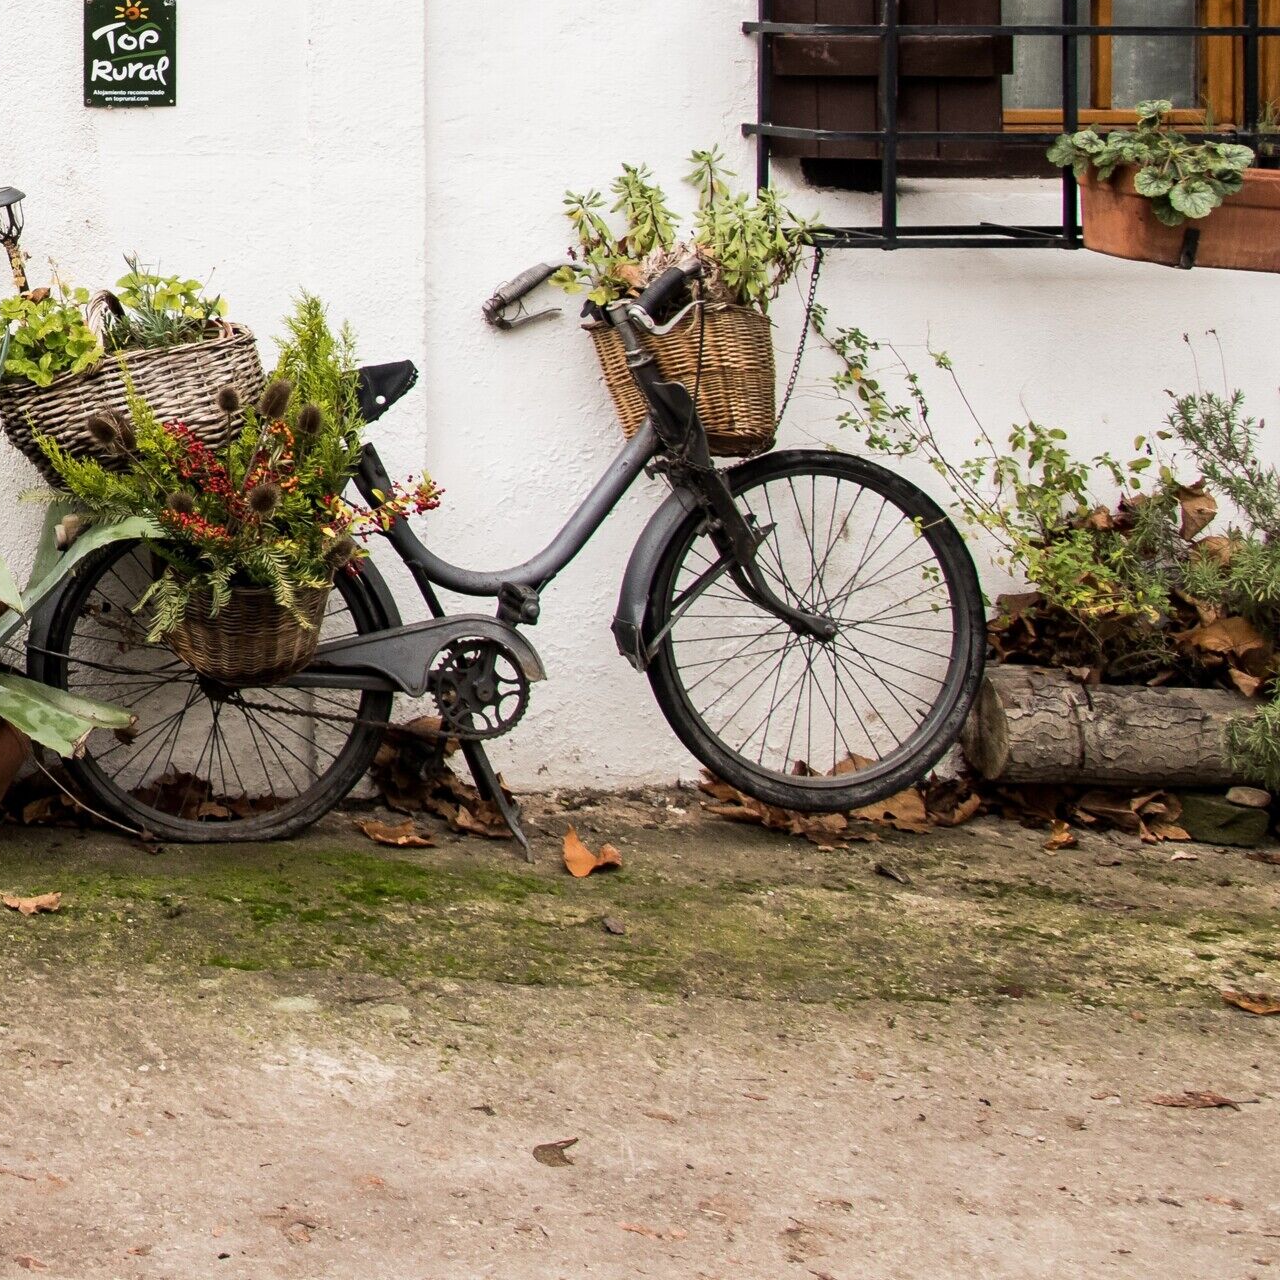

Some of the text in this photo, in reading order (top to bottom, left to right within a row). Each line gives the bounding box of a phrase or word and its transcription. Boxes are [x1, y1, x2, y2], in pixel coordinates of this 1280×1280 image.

[91, 21, 159, 55] Top
[90, 56, 170, 86] Rural
[93, 89, 127, 97] Alojamiento
